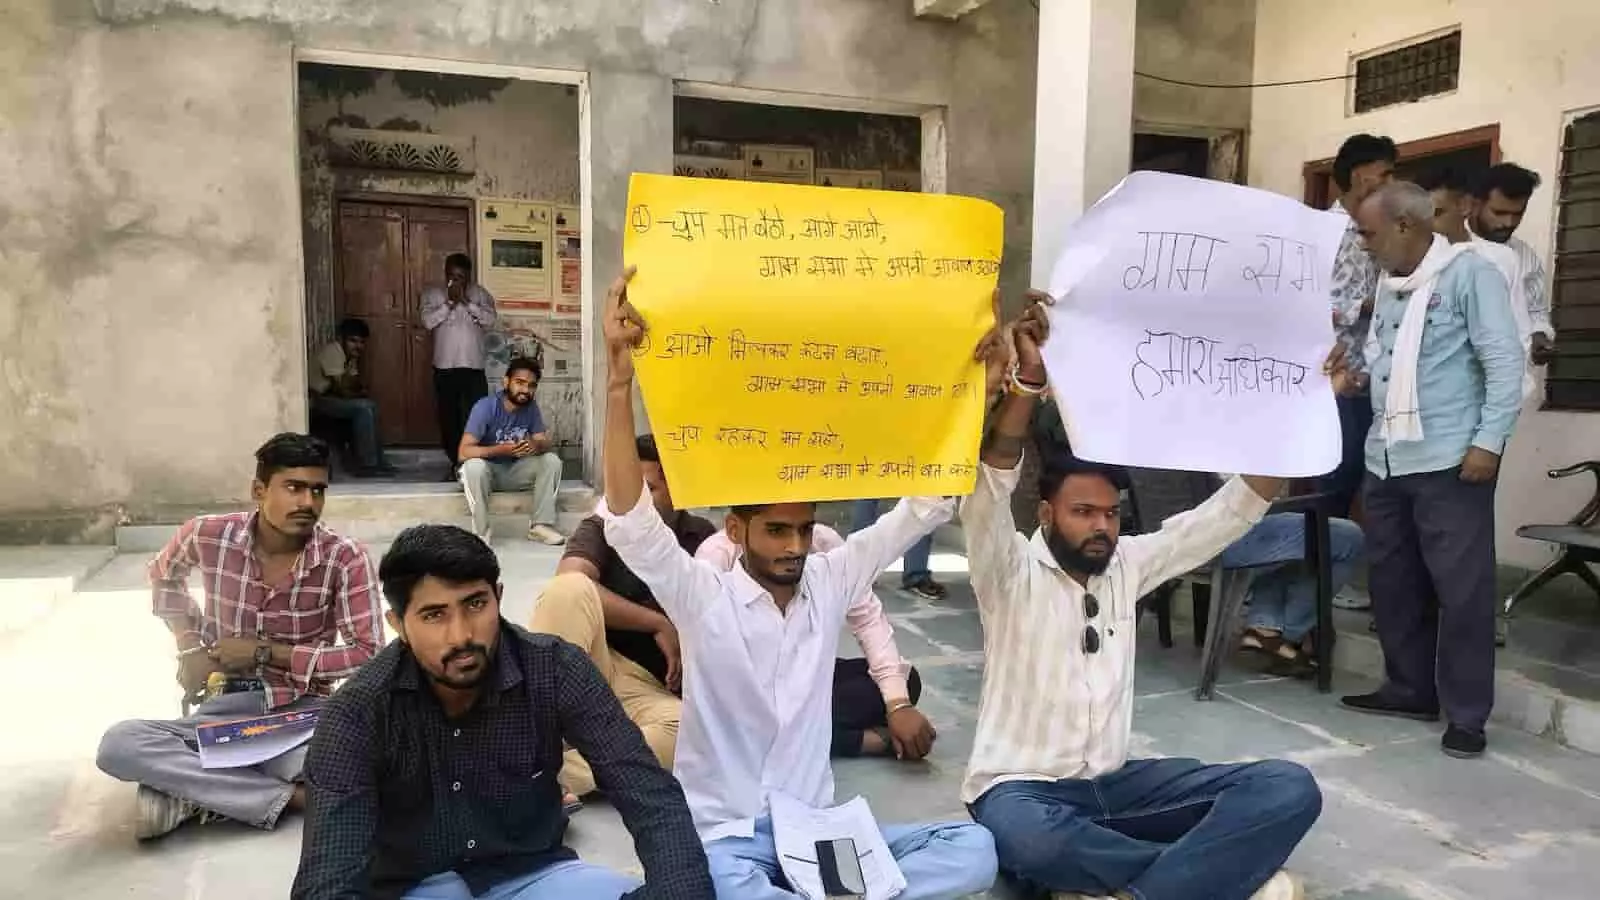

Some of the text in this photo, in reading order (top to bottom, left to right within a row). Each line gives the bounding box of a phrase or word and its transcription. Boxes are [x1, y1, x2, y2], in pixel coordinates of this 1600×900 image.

[656, 210, 708, 241] चुप
[716, 213, 749, 240] मत
[800, 212, 840, 238] आगे
[758, 256, 800, 277] ग्राम
[806, 256, 849, 277] सभा
[886, 249, 928, 278] अपनी
[1123, 231, 1321, 296] ग्राम सभा
[656, 326, 717, 358] आओ
[1131, 329, 1312, 401] हमारा अधिकार
[859, 374, 894, 398] अपनी
[820, 463, 852, 481] सभा
[876, 455, 916, 480] अपनी
